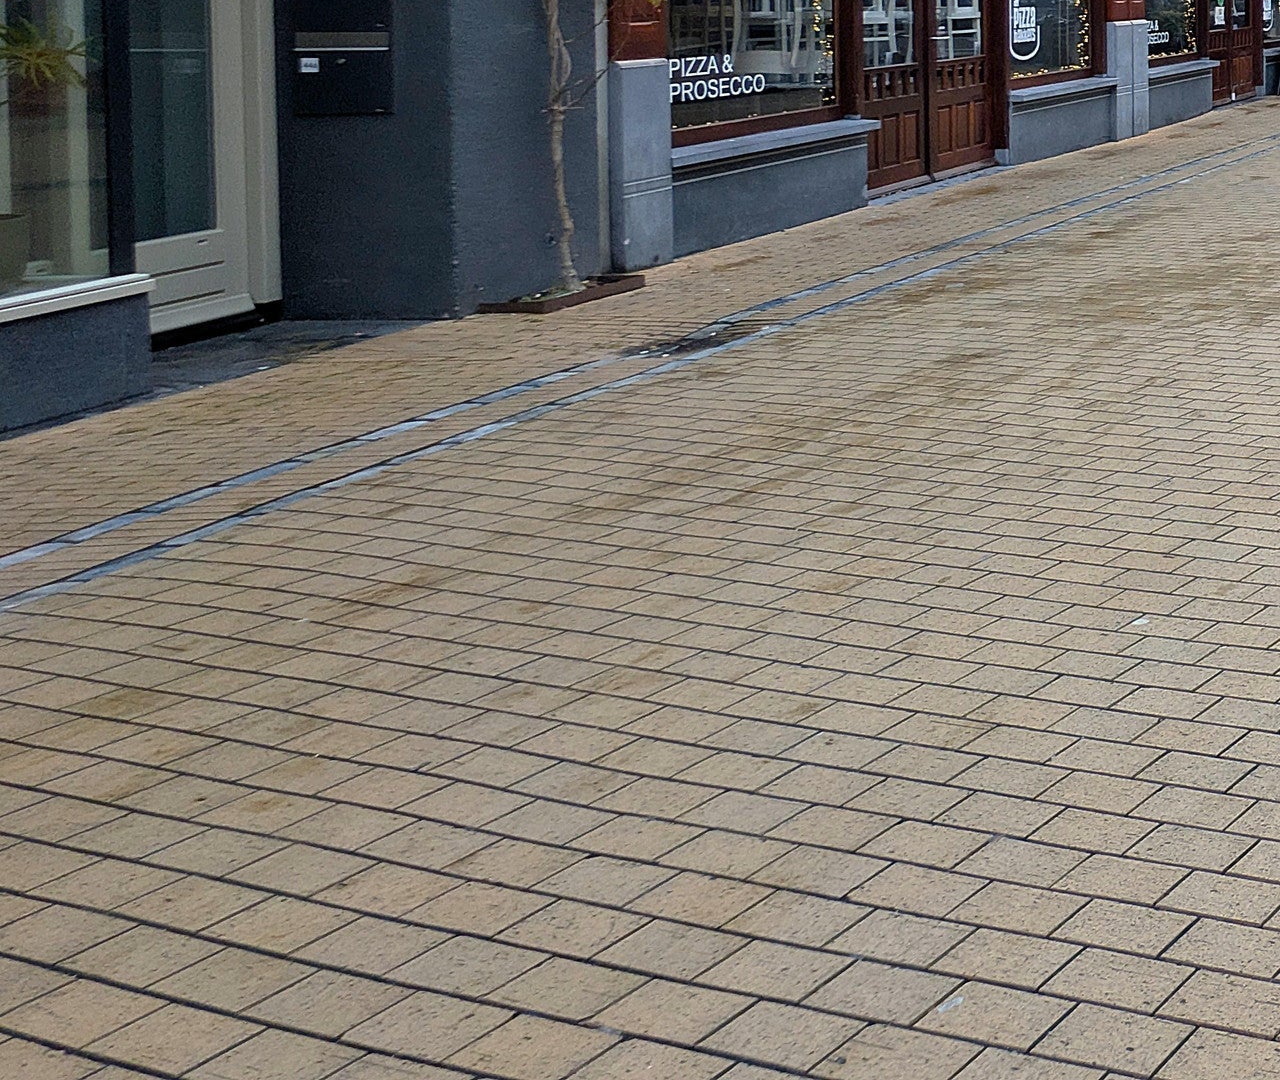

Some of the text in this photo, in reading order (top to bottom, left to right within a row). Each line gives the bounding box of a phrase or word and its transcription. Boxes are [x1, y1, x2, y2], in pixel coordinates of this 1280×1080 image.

[669, 54, 734, 78] PIZZA &
[669, 74, 766, 104] PROSECCO
